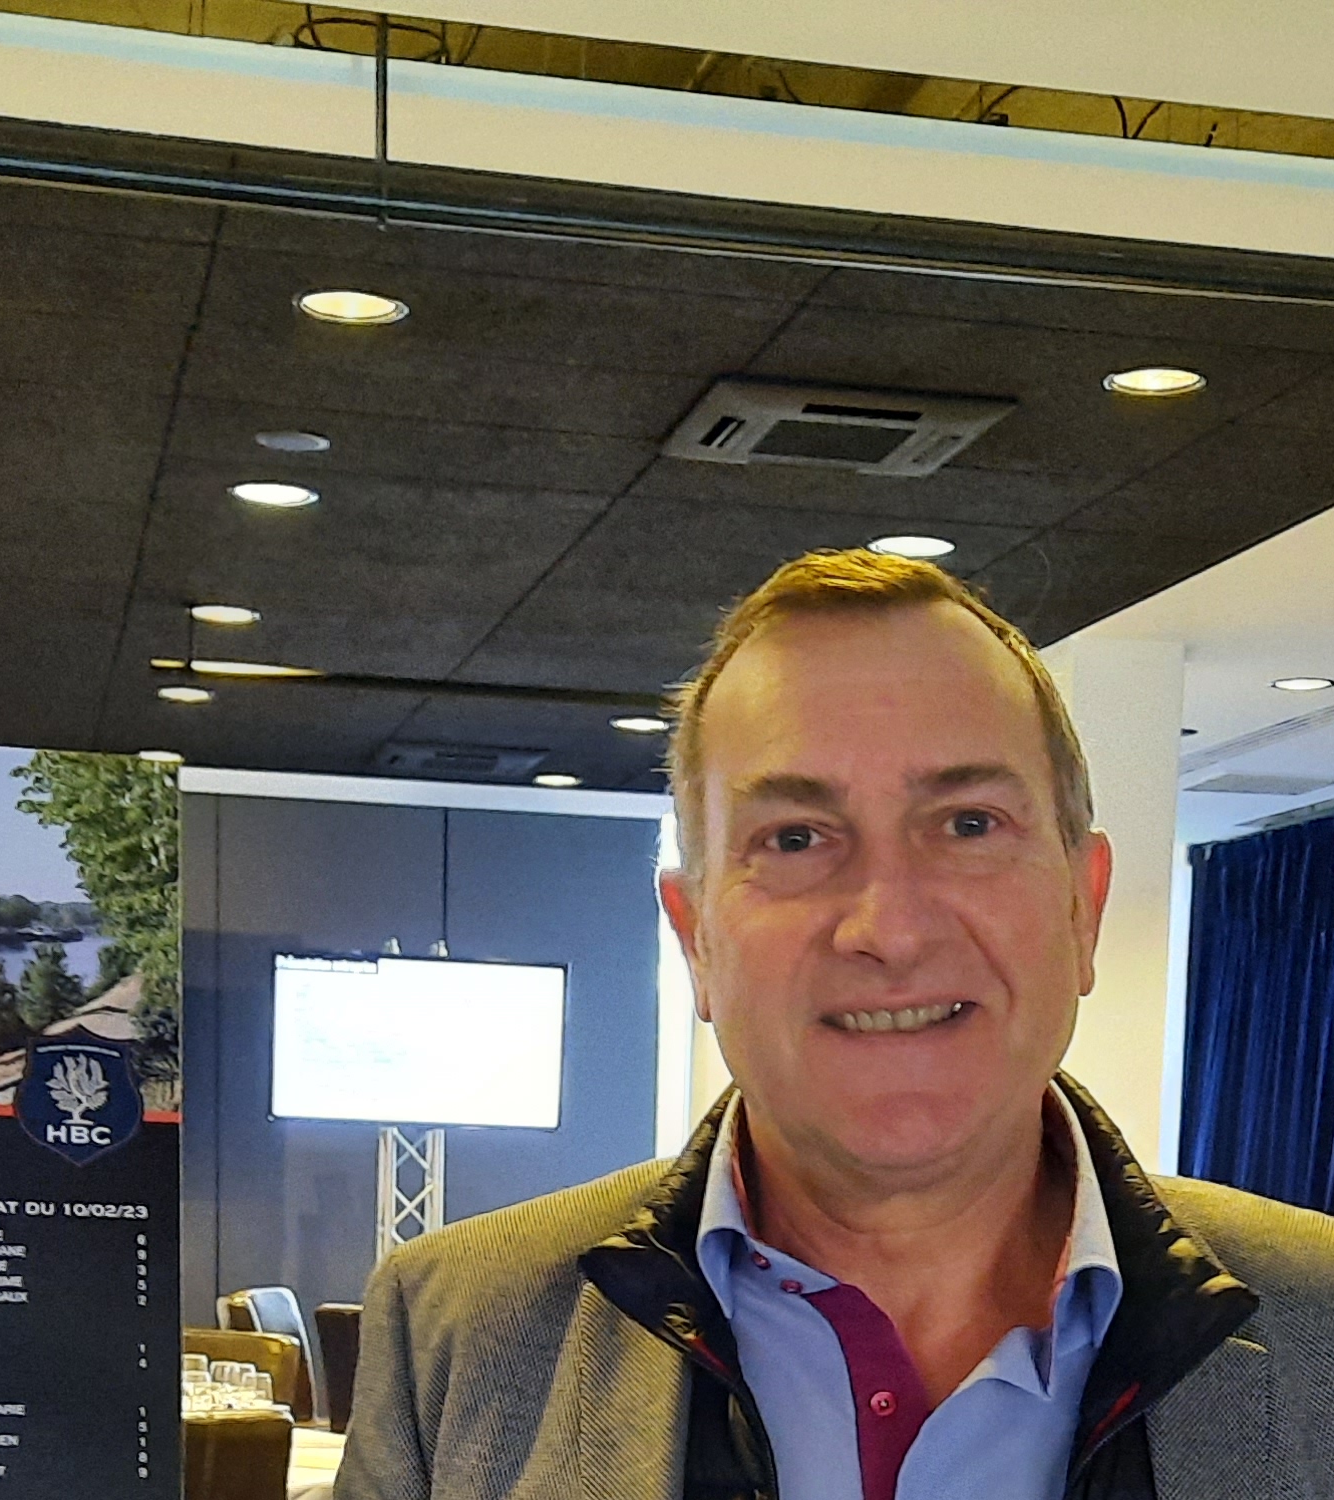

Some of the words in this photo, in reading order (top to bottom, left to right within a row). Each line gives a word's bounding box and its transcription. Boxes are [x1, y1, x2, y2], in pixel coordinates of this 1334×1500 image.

[46, 1123, 112, 1146] HBC
[25, 1203, 54, 1215] DU
[63, 1203, 149, 1219] 10/02/23
